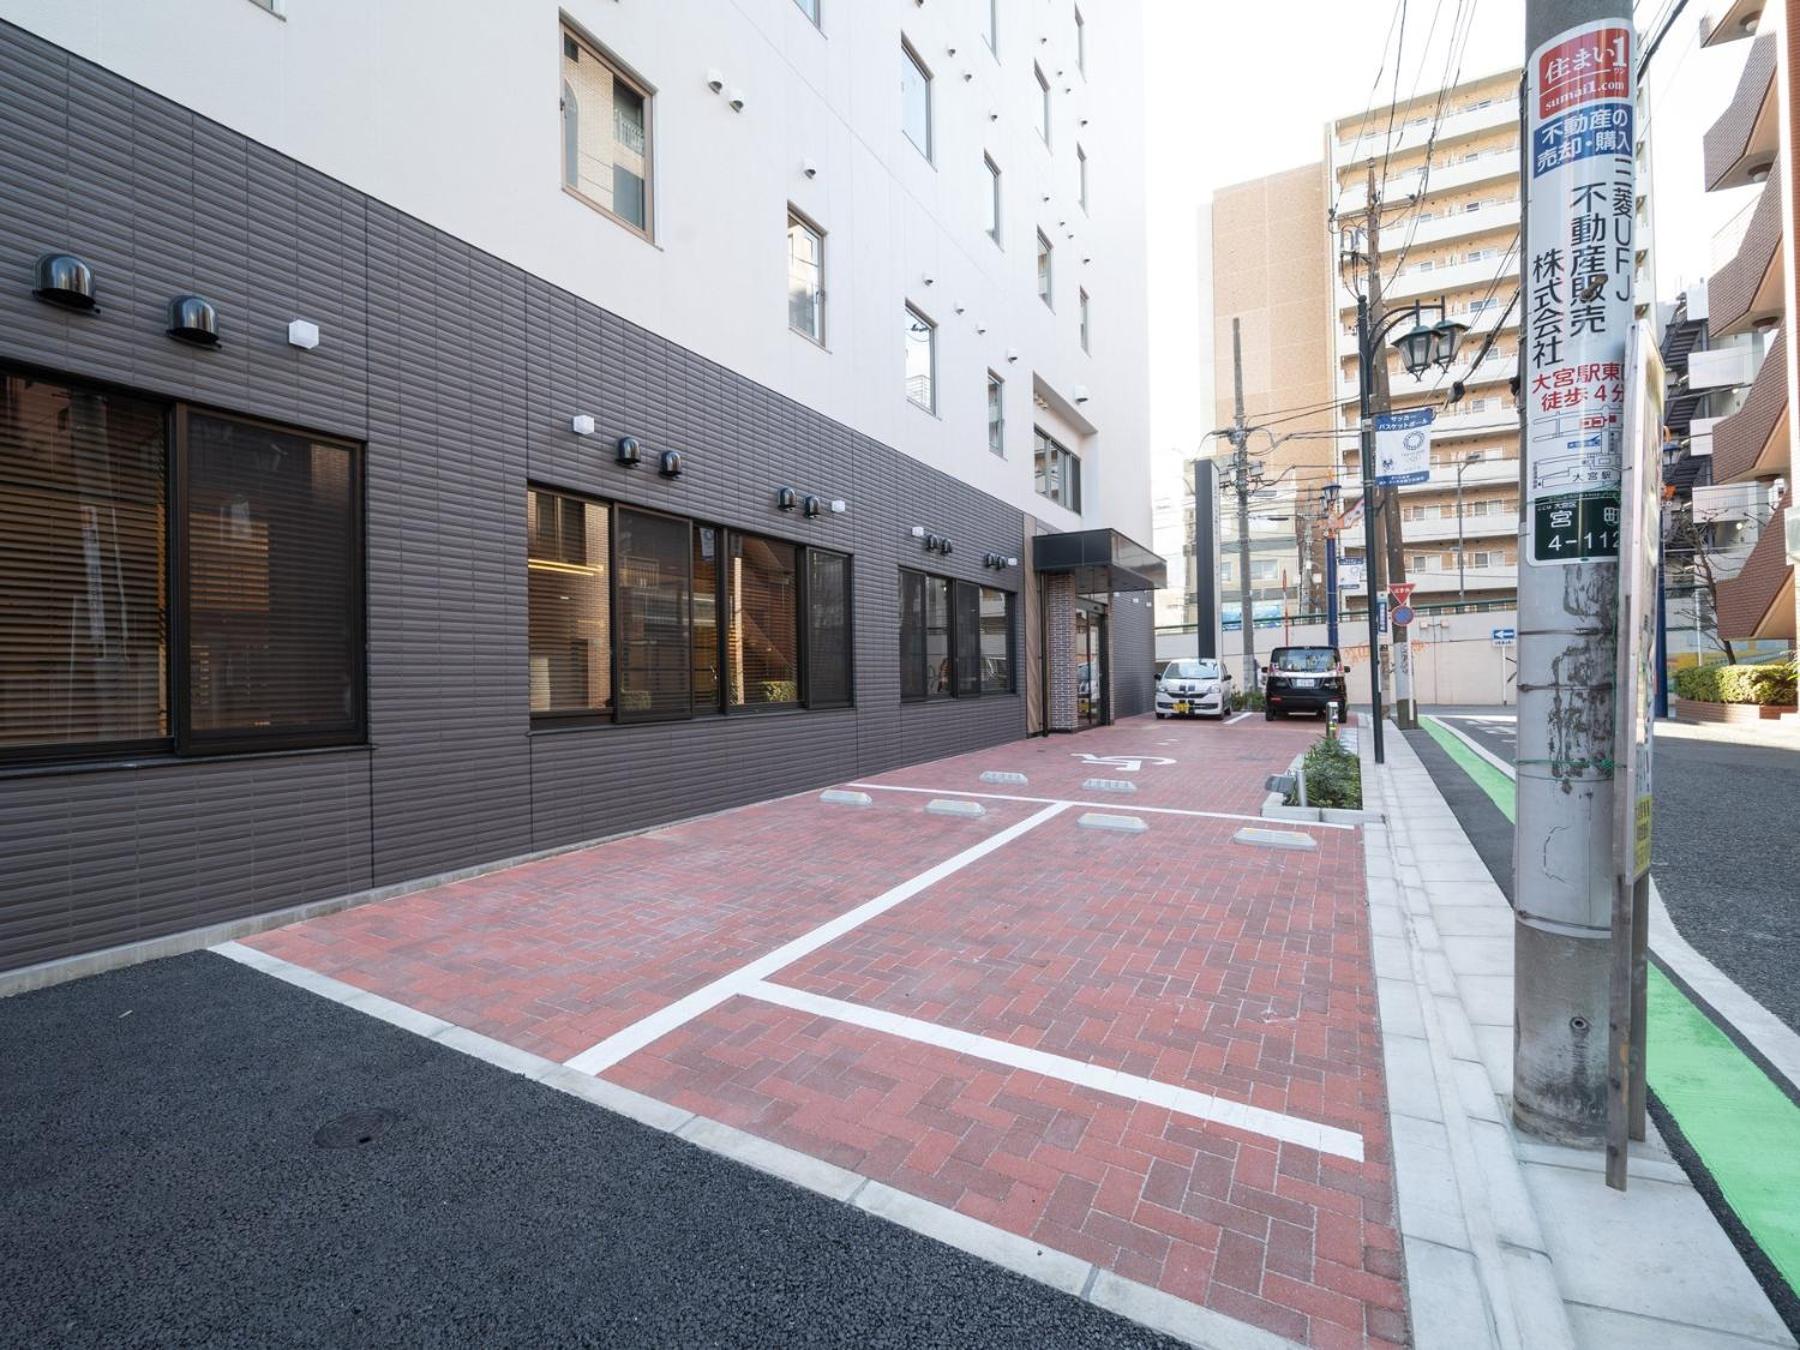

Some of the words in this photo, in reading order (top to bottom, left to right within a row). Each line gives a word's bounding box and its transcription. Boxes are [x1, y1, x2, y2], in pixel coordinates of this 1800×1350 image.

[1545, 36, 1627, 84] 住まい1
[1545, 80, 1624, 110] sumai1.com
[1542, 108, 1629, 145] 不動産の
[1537, 130, 1631, 173] 売却・購入
[1612, 157, 1632, 302] 三菱UFJ
[1570, 184, 1607, 336] 不動産販売
[1532, 248, 1564, 369] 株式会社
[1532, 362, 1624, 394] 大宮駅東
[1572, 471, 1612, 482] 大宮駅
